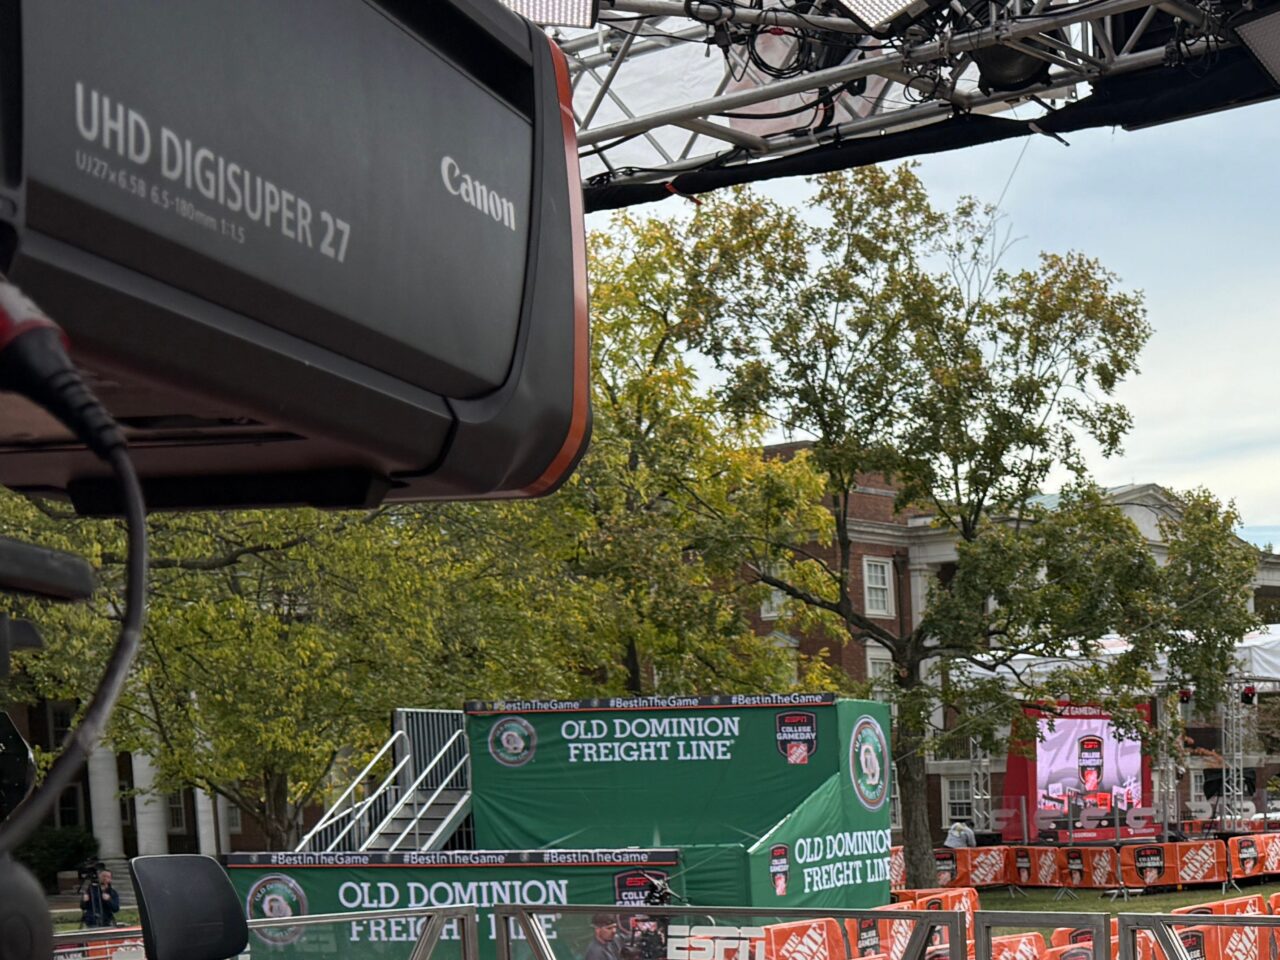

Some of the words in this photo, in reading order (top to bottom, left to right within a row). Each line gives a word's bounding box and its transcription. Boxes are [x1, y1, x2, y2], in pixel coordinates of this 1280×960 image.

[75, 81, 151, 165] UHD
[160, 126, 313, 249] DIGISUPER
[319, 210, 351, 263] 27
[440, 154, 516, 232] Canon
[609, 696, 699, 709] #BestInTheGame
[731, 692, 822, 705] #BestInTheGame
[560, 719, 608, 740] OLD
[613, 716, 741, 739] DOMINION
[567, 741, 671, 763] FREIGHT
[677, 739, 732, 761] LINE
[271, 853, 370, 866] #BestInTheGame
[403, 852, 504, 865] #BestInTheGame
[543, 850, 649, 863] #BestInTheGame
[794, 836, 824, 864] OLD
[825, 828, 891, 860] DOMINION
[1178, 842, 1216, 881] HOME
[626, 877, 650, 886] ESP
[803, 860, 863, 894] FREIGHT
[338, 880, 400, 909] OLD
[406, 879, 568, 908] DOMINION
[621, 891, 651, 900] COLL
[349, 916, 479, 942] FREIH
[779, 932, 801, 958] THE
